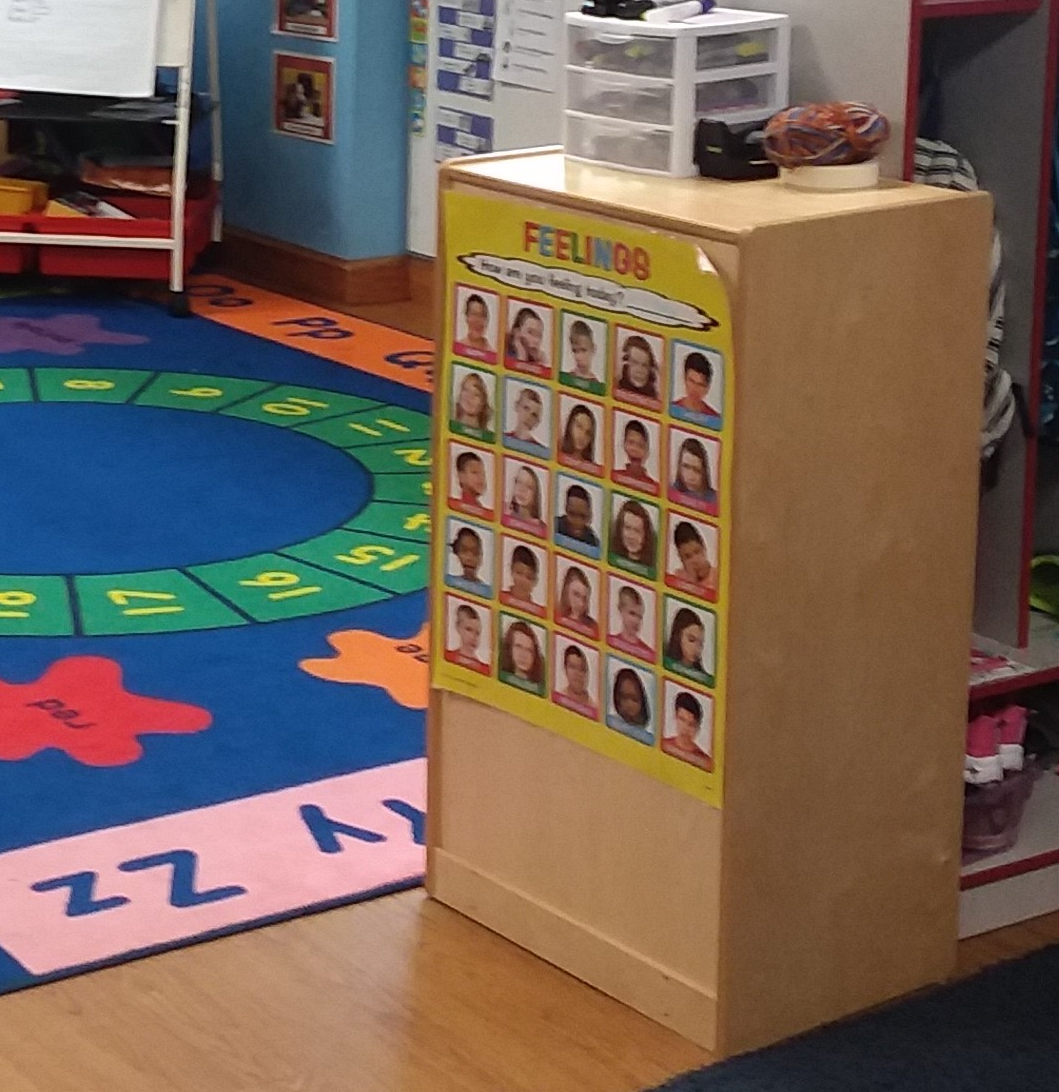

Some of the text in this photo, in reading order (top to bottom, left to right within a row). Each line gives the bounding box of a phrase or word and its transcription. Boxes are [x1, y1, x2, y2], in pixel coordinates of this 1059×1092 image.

[523, 221, 651, 281] FEELINGS
[271, 316, 355, 340] Pp
[62, 378, 116, 392] 8
[169, 387, 224, 399] 9
[261, 397, 330, 417] 10
[348, 418, 410, 437] 11
[336, 544, 420, 572] 15
[239, 571, 322, 601] 16
[107, 588, 185, 618] 17
[26, 698, 98, 729] red
[33, 850, 245, 918] Zz
